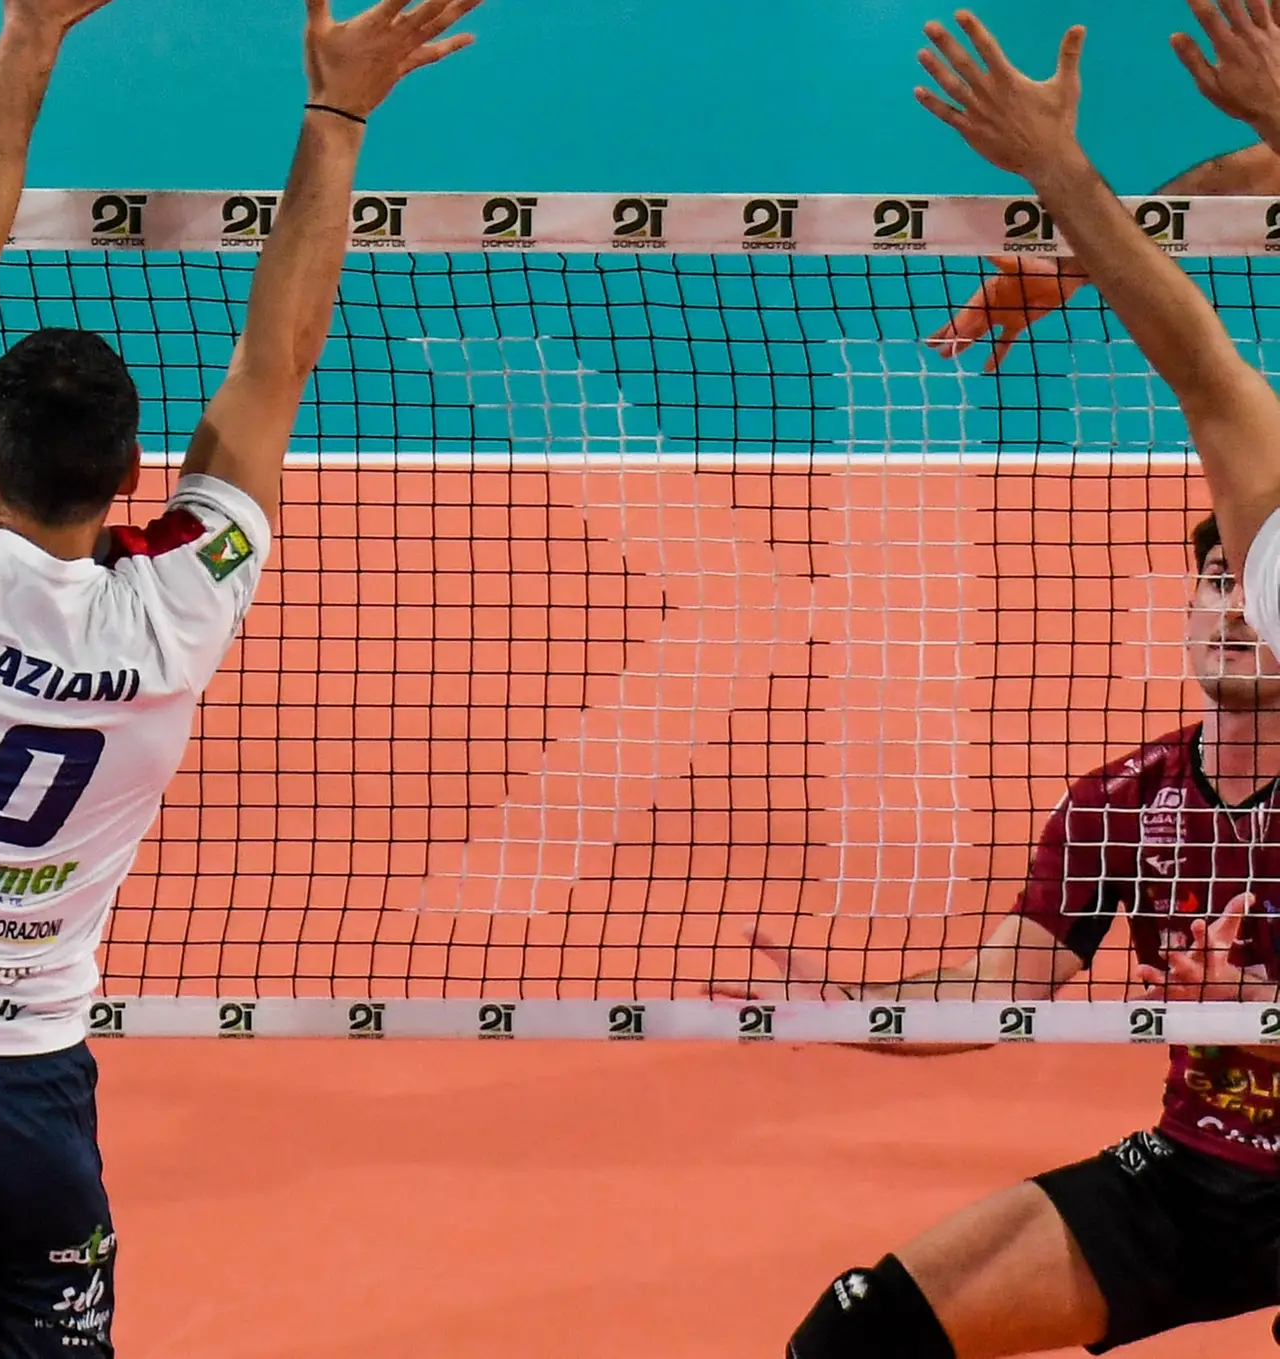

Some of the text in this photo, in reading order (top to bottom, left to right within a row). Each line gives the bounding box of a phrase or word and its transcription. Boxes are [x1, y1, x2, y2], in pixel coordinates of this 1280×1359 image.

[91, 237, 147, 247] DOMOTEK
[352, 239, 408, 249] DOMOTEK
[482, 240, 538, 250] DOMOTEK
[612, 241, 668, 251] DOMOTEK
[743, 241, 799, 251] DOMOTEK
[873, 242, 929, 252] DOMOTEK
[1003, 243, 1059, 253] DOMOTEK
